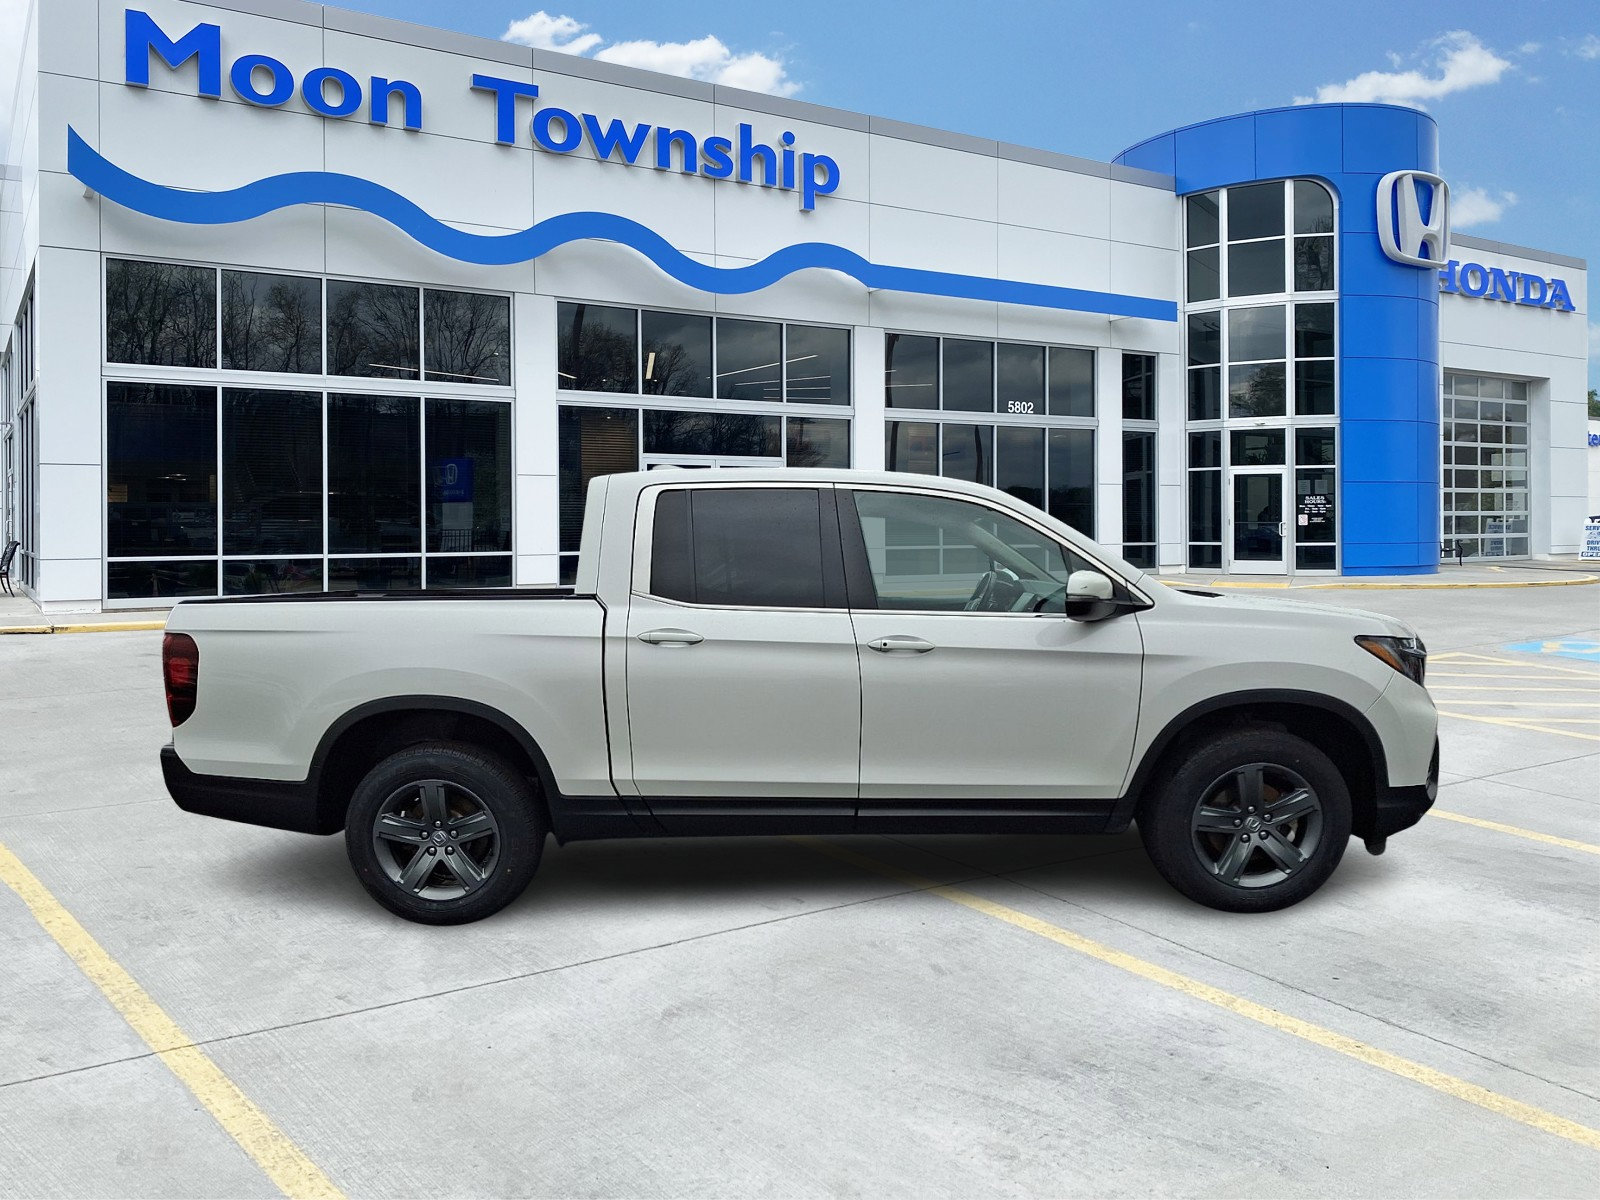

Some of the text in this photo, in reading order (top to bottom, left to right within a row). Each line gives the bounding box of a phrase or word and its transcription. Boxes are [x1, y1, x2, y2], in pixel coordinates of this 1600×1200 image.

[125, 9, 840, 212] Moon Township
[1007, 400, 1034, 414] 5802
